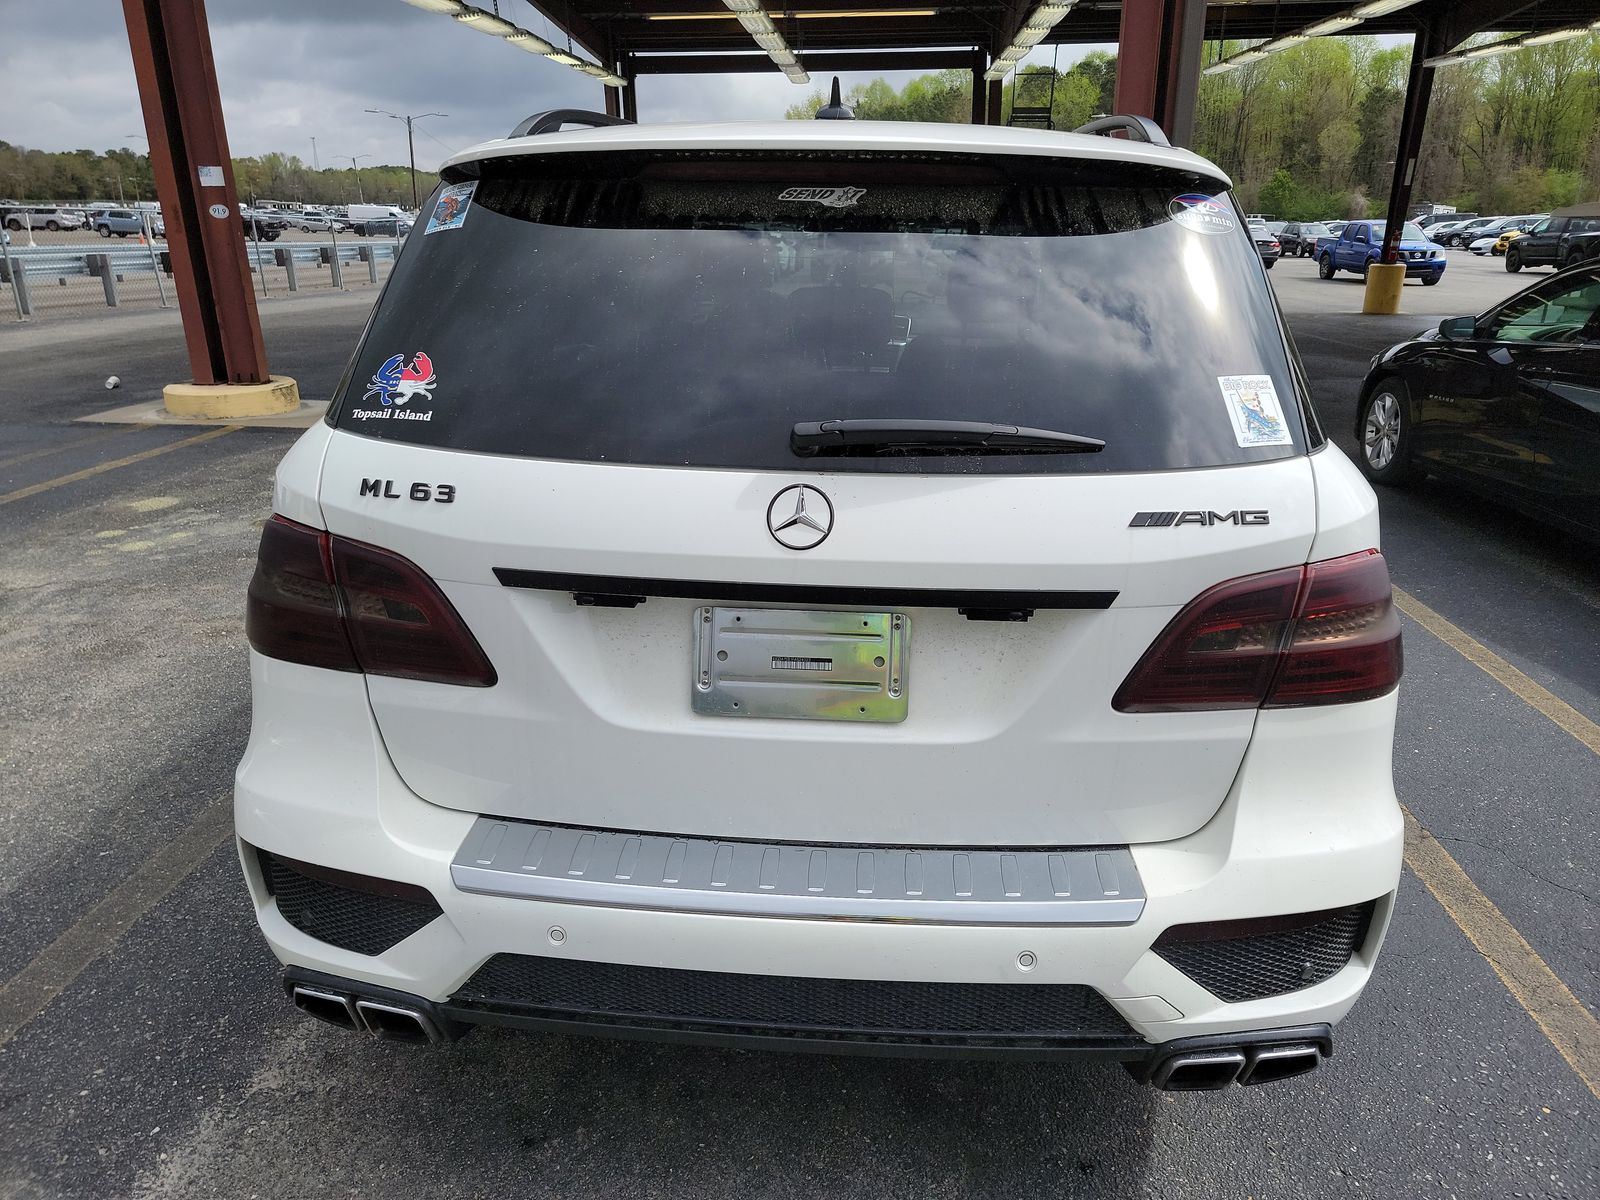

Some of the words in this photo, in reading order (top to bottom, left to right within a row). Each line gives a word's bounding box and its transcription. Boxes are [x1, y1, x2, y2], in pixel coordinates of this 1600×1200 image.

[212, 207, 227, 215] 91.9
[1212, 215, 1233, 228] mtn
[352, 408, 392, 420] Topsail
[393, 409, 433, 421] Island
[360, 478, 401, 499] ML
[409, 482, 456, 503] 63
[1174, 510, 1270, 527] AMG
